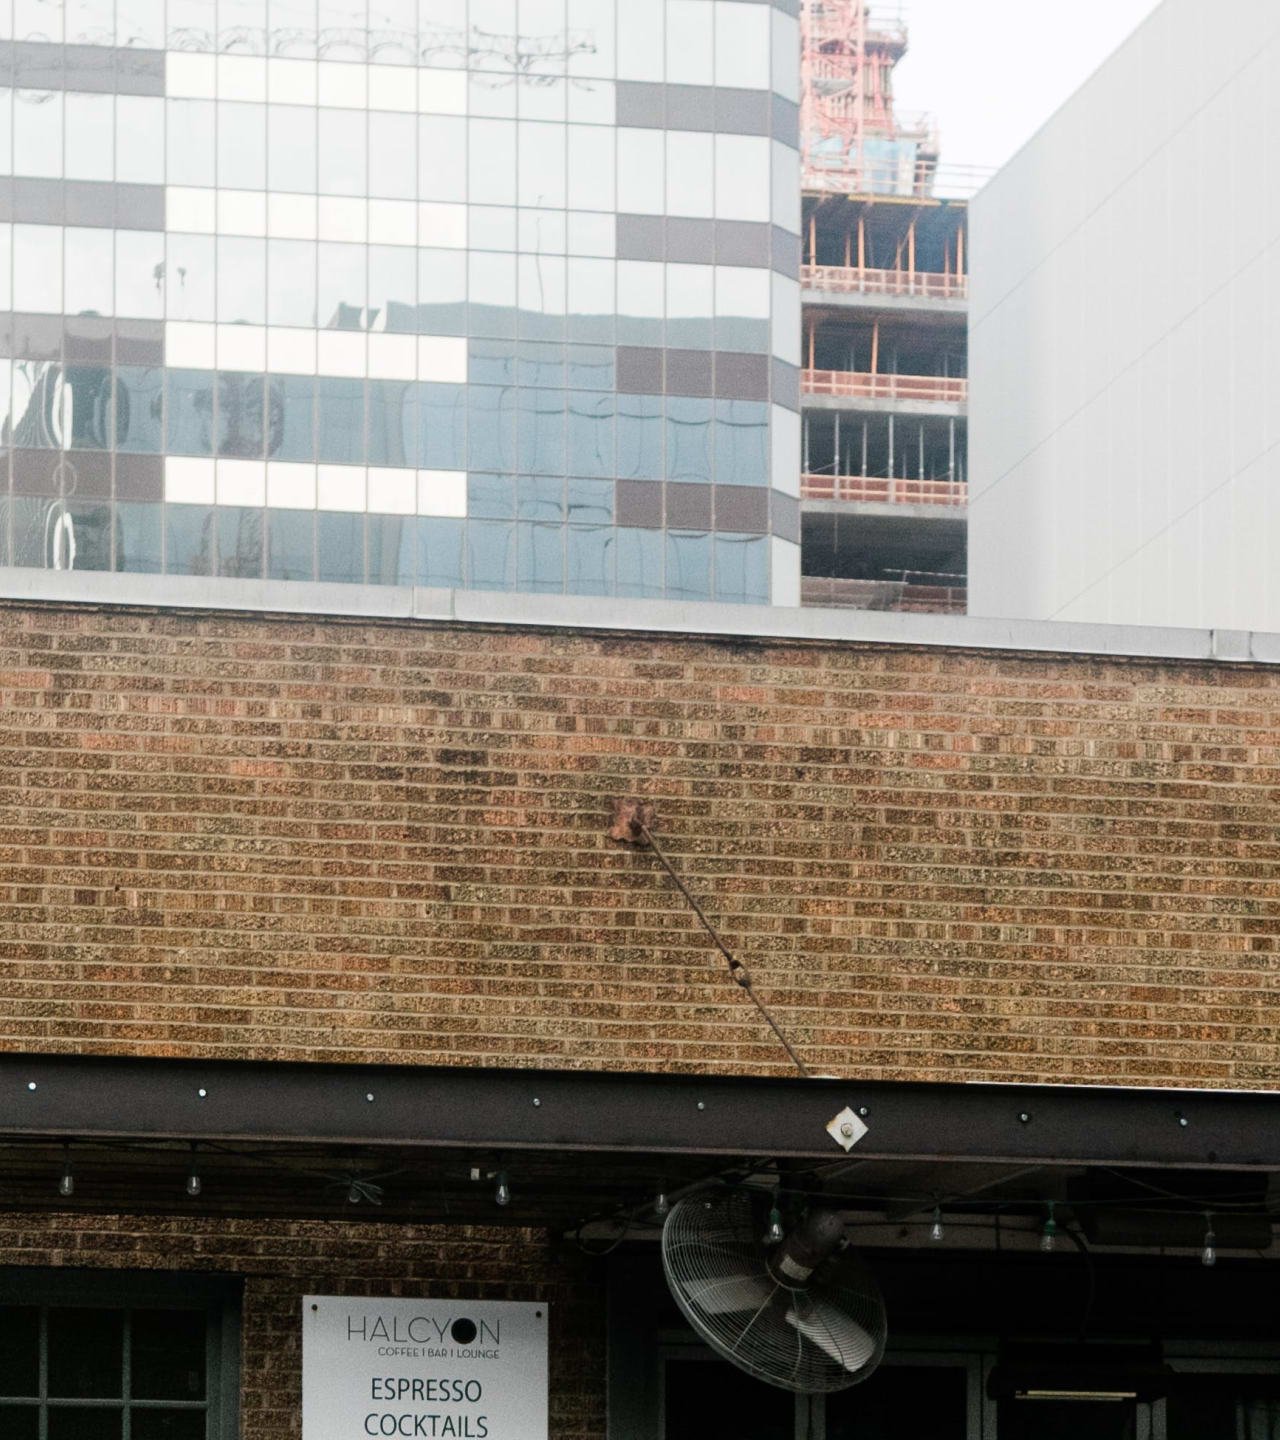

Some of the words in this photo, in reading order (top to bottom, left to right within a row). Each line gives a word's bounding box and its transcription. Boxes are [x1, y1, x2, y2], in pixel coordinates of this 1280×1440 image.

[347, 1316, 500, 1345] HALCYON
[377, 1347, 419, 1358] COFFEE
[428, 1348, 448, 1358] BAR
[456, 1348, 500, 1360] LOUNGE
[371, 1377, 483, 1403] ESPRESSO
[364, 1413, 489, 1439] COCKTAILS
